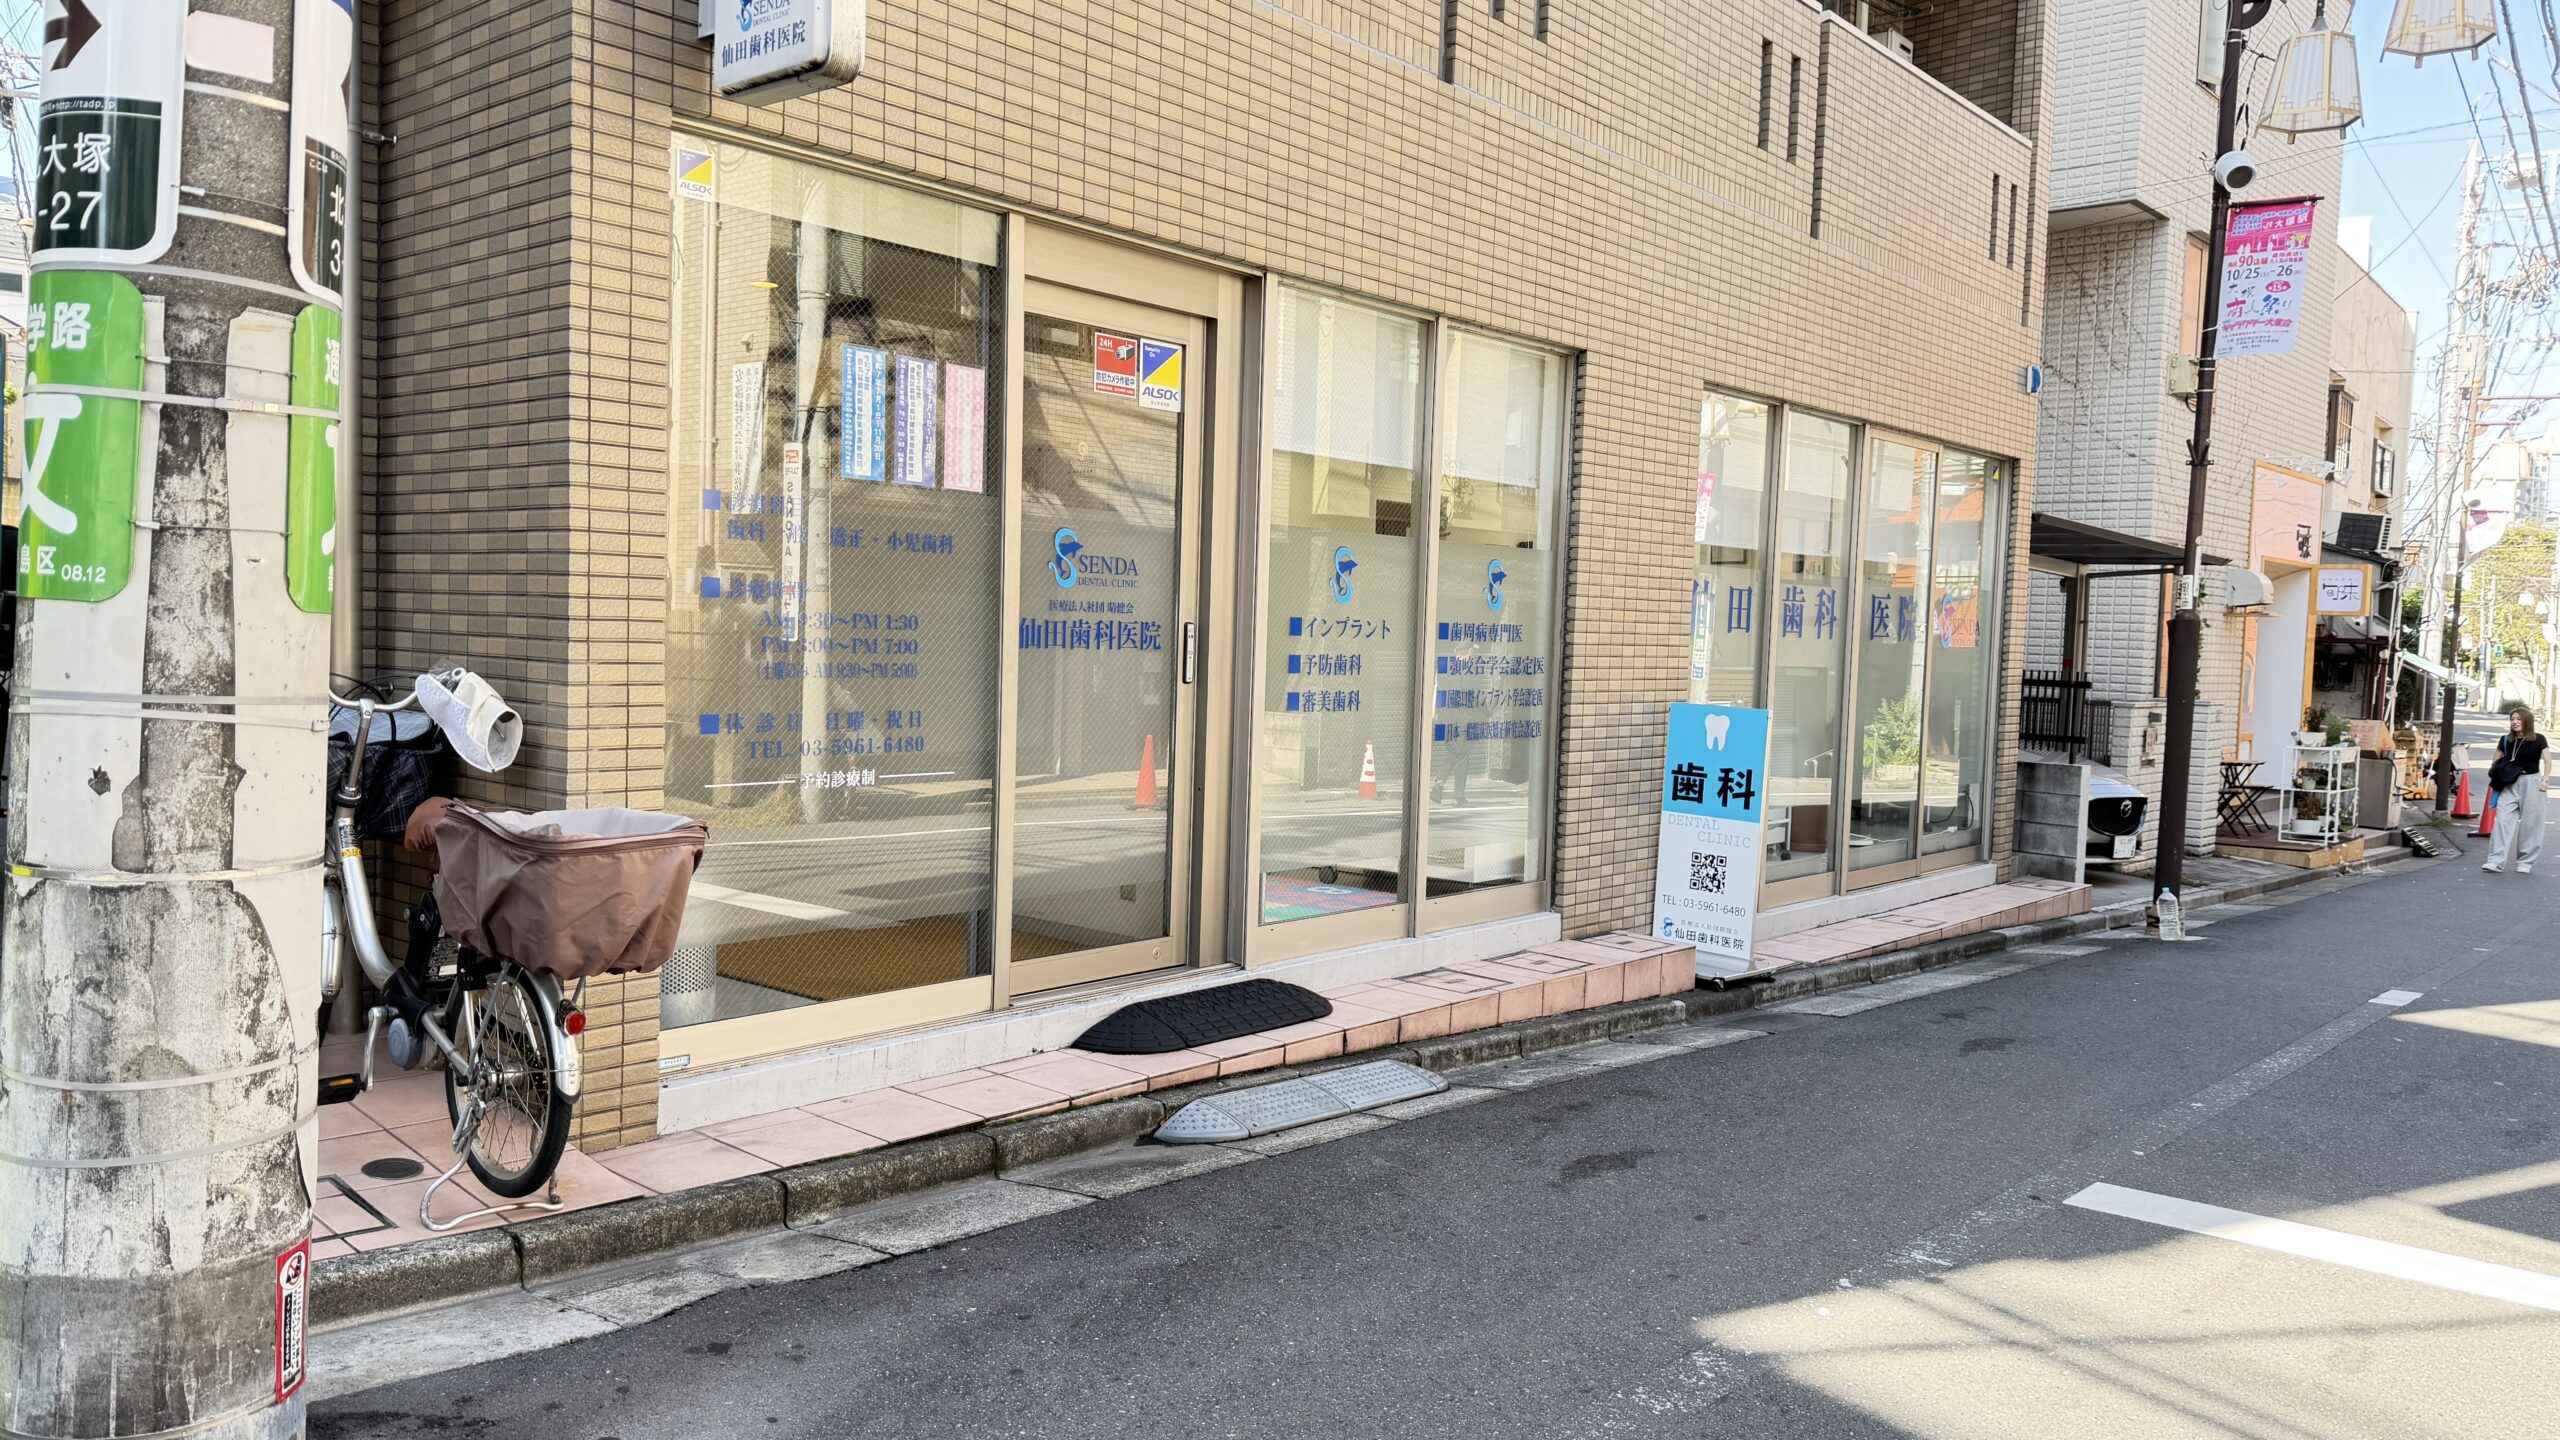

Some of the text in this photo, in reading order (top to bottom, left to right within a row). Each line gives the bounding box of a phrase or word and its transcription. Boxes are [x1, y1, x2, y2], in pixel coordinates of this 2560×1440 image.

[722, 19, 806, 68] 仙田歯科医院
[680, 181, 712, 196] ALSOK
[1099, 338, 1113, 348] 24H
[1142, 387, 1179, 402] ALSOK
[61, 564, 106, 583] 08.12
[1079, 554, 1139, 577] SENDA
[1078, 577, 1139, 588] DENTAL CLINIC
[1019, 617, 1162, 650] 仙田歯科医院
[1304, 616, 1392, 640] インプラント
[1450, 621, 1523, 642] 歯周病専門医
[1303, 653, 1363, 676] 予防歯科
[1449, 655, 1545, 676] 顎咬合学会認定医
[1302, 690, 1361, 713] 審美歯科
[801, 735, 925, 757] 03-5961-6480
[800, 768, 876, 789] 予約診療制
[1671, 762, 1756, 811] 歯科
[1667, 813, 1720, 831] DENTAL
[1697, 831, 1752, 849] CLINIC
[1675, 927, 1744, 950] 仙田歯科医院
